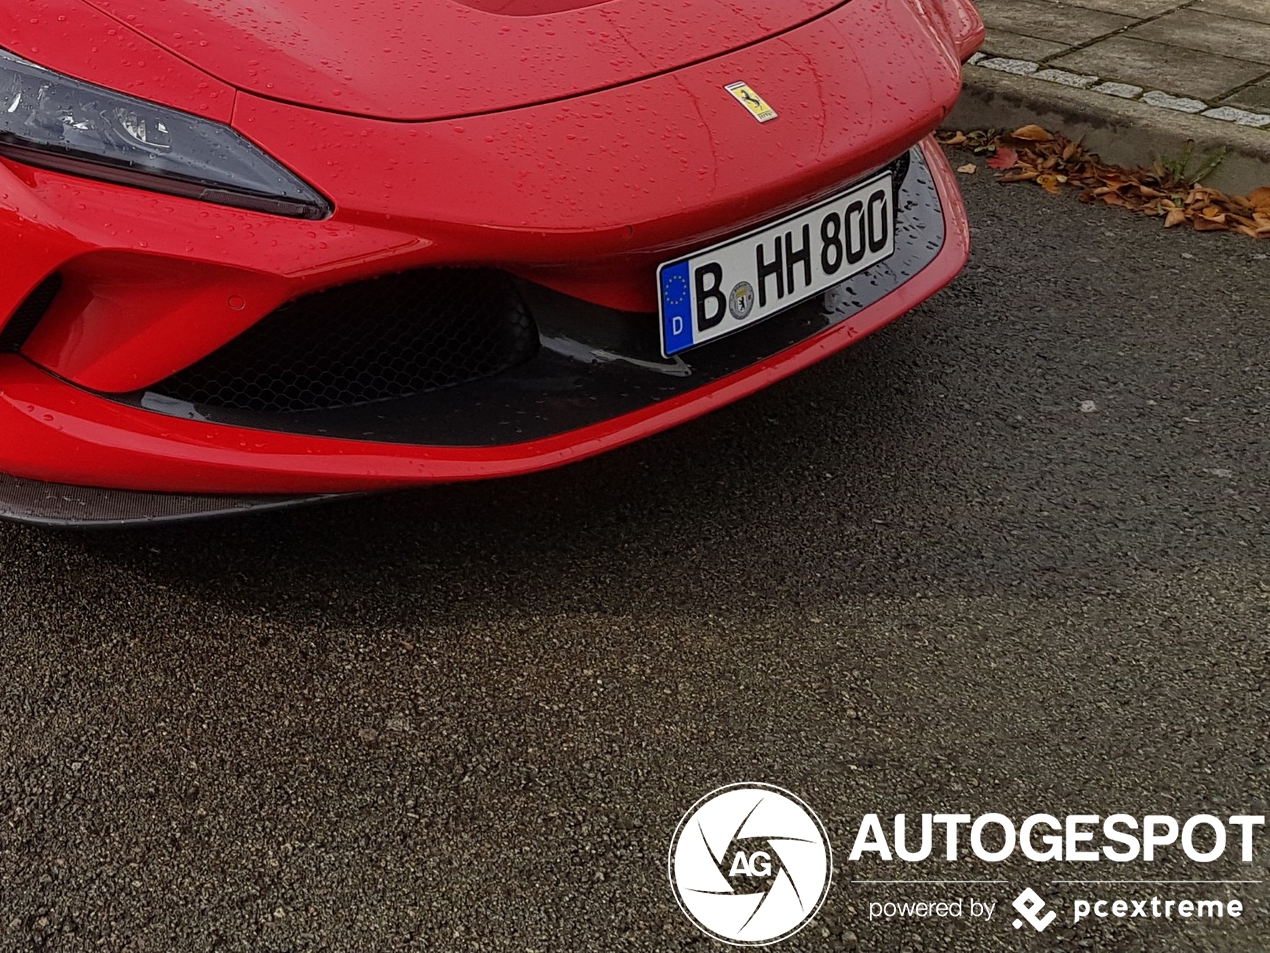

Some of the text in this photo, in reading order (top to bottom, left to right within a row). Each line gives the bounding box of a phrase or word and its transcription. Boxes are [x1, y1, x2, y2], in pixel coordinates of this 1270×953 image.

[695, 189, 889, 332] B HH 800
[672, 316, 683, 335] D
